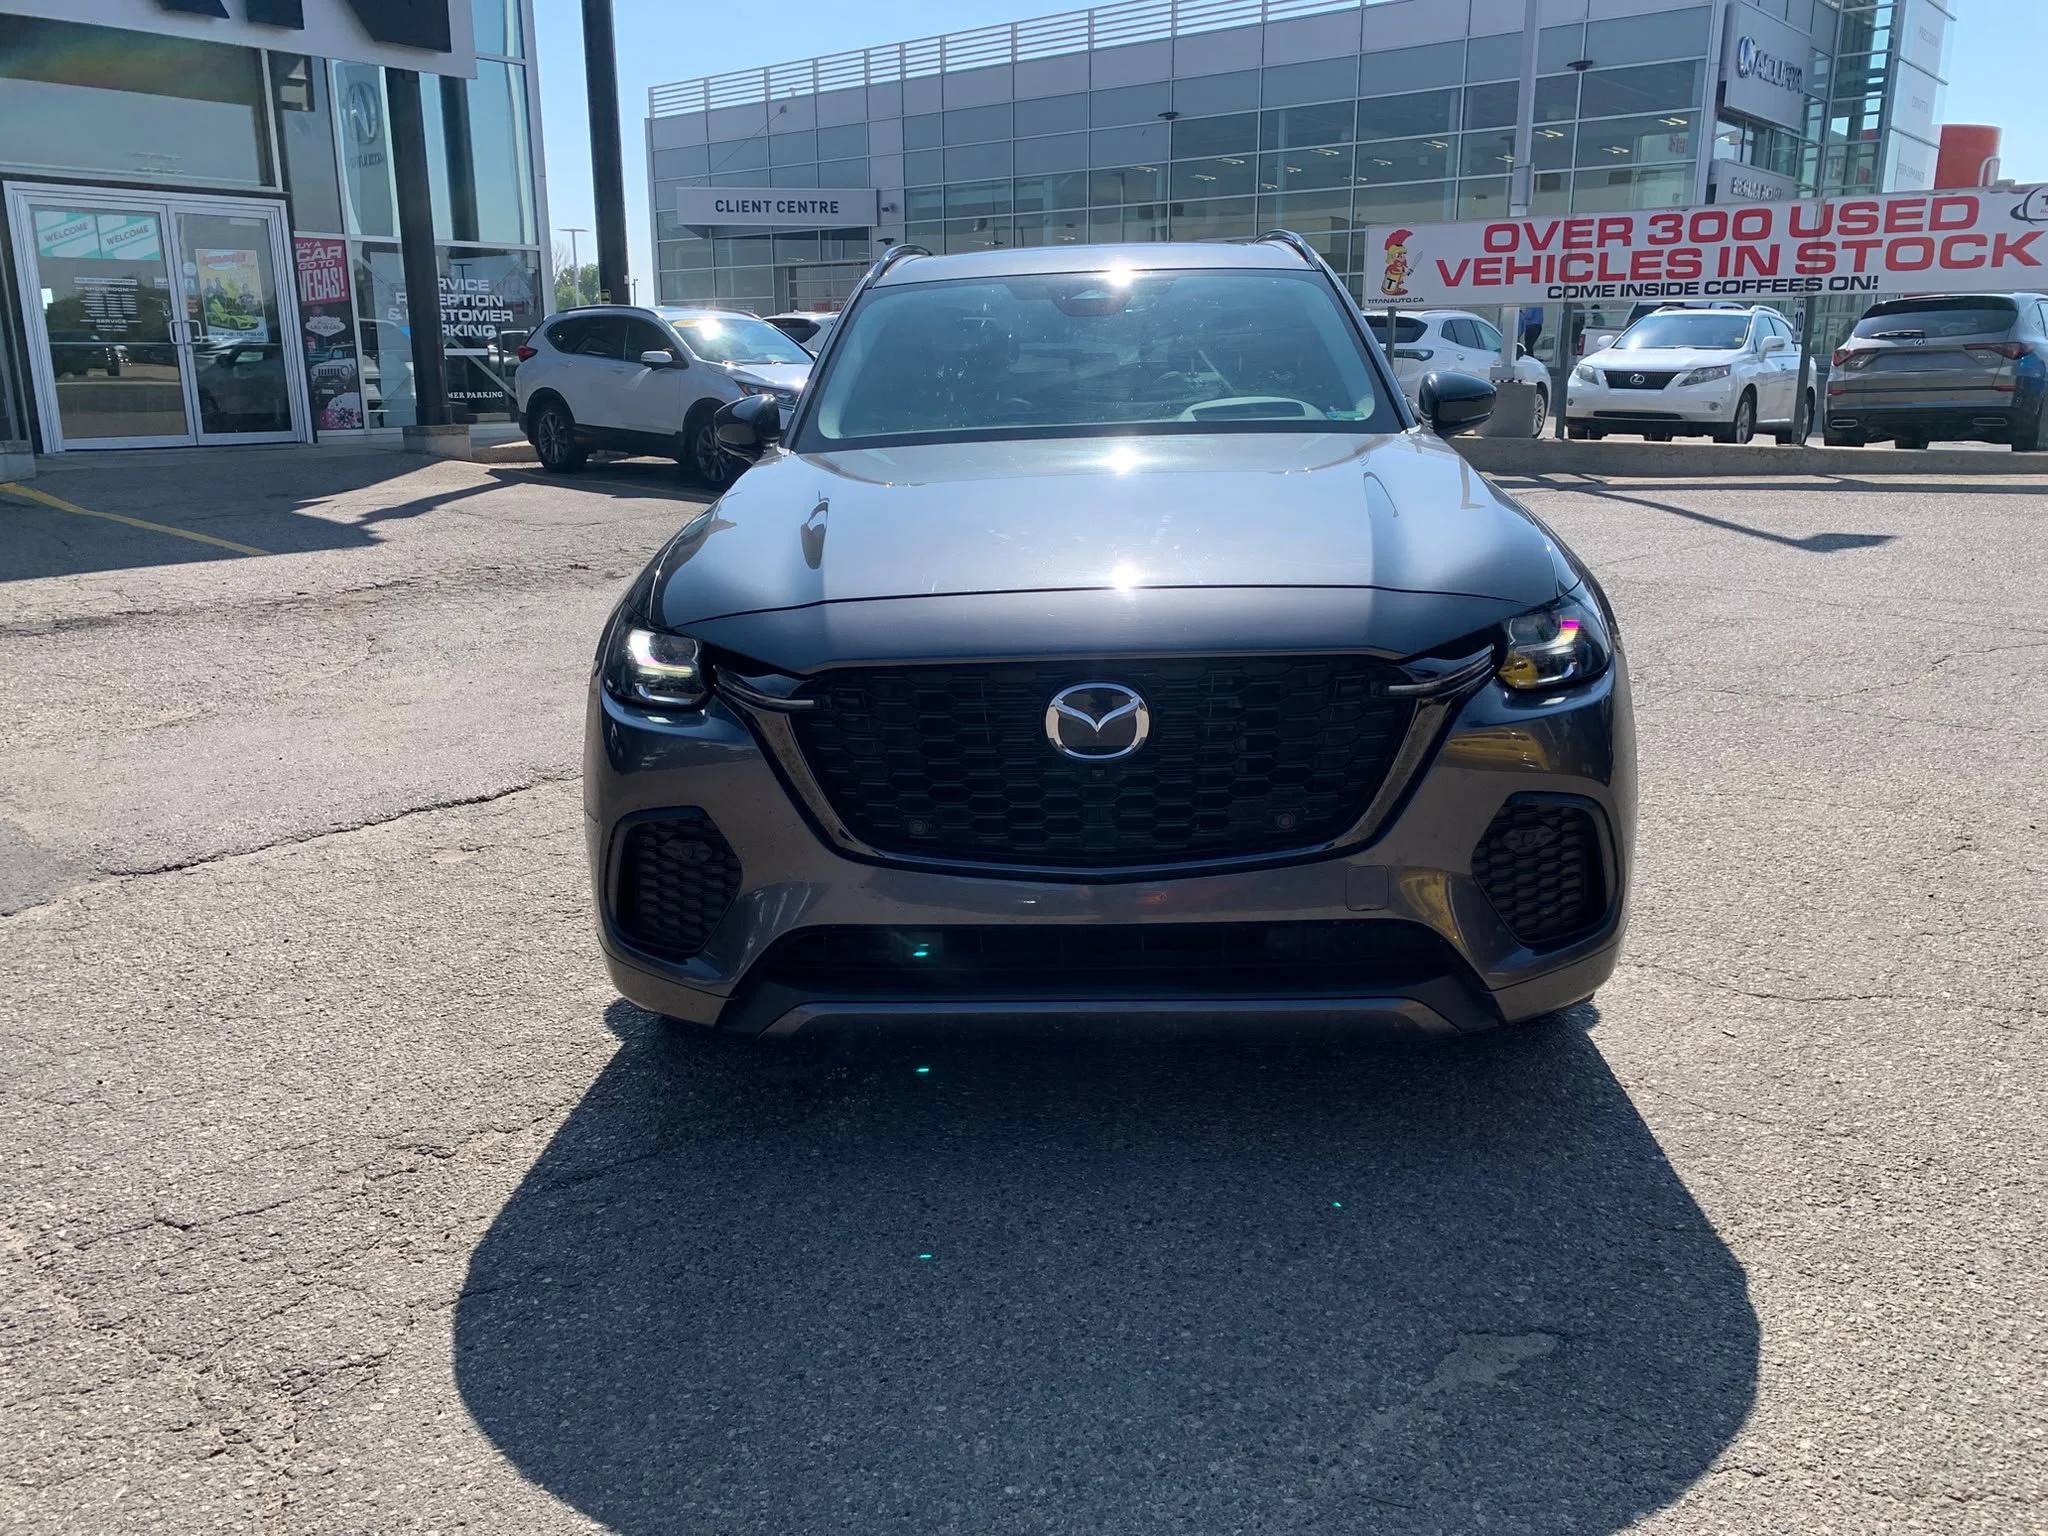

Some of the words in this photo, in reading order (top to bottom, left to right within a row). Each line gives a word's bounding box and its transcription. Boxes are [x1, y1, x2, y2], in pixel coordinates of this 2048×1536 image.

[715, 199, 772, 213] CLIENT
[776, 200, 839, 214] CENTRE
[44, 222, 89, 243] WELCOME
[106, 224, 150, 246] WELCOME
[1484, 217, 1633, 253] OVER
[1648, 208, 1773, 246] 300
[1789, 196, 1979, 238] USED
[296, 246, 342, 263] CAR
[299, 261, 316, 270] GO
[318, 259, 335, 268] TO
[1436, 247, 1703, 287] VEHICLES
[1718, 244, 1781, 277] IN
[1795, 230, 2046, 275] STOCK
[298, 266, 345, 302] VEGAS!
[438, 278, 490, 292] RVICE
[1547, 284, 1615, 299] COME
[1620, 281, 1699, 298] INSIDE
[1704, 276, 1823, 295] COFFEES
[1829, 275, 1879, 292] ON!
[441, 325, 497, 337] RKING
[1795, 311, 1804, 332] 10
[466, 391, 504, 399] PARKING
